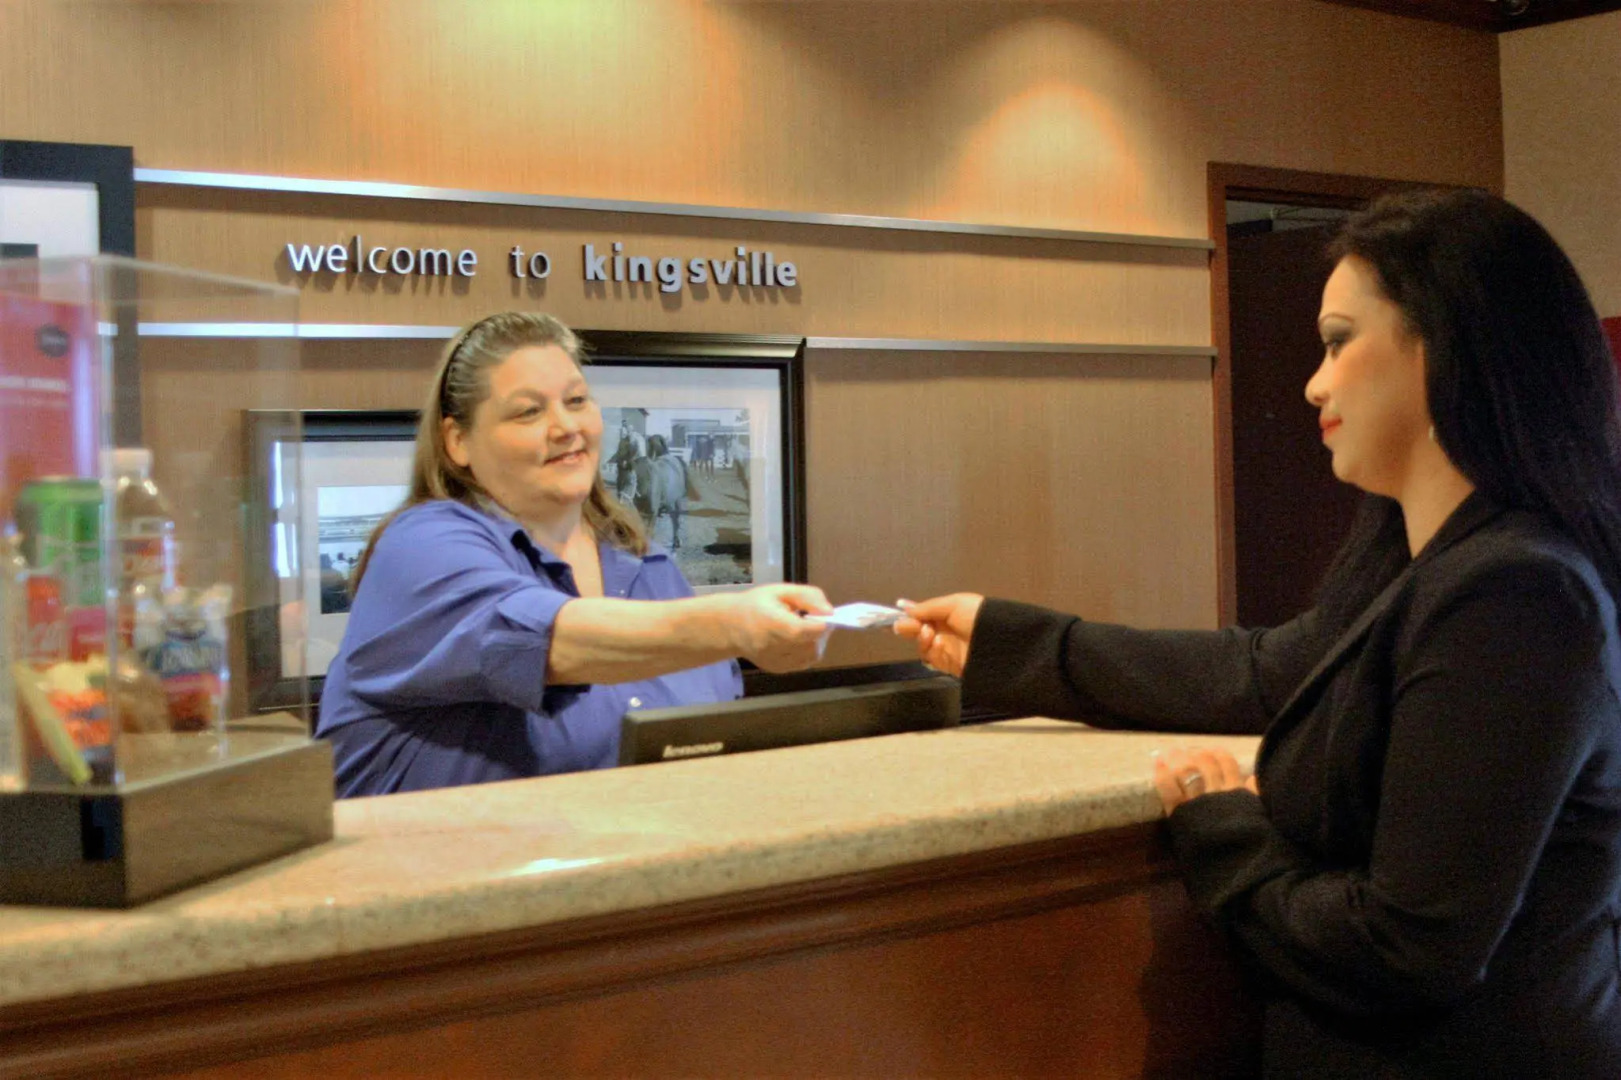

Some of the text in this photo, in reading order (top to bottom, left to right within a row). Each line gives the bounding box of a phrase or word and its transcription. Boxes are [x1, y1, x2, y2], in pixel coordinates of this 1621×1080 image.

[286, 234, 798, 293] welcome to kingsville
